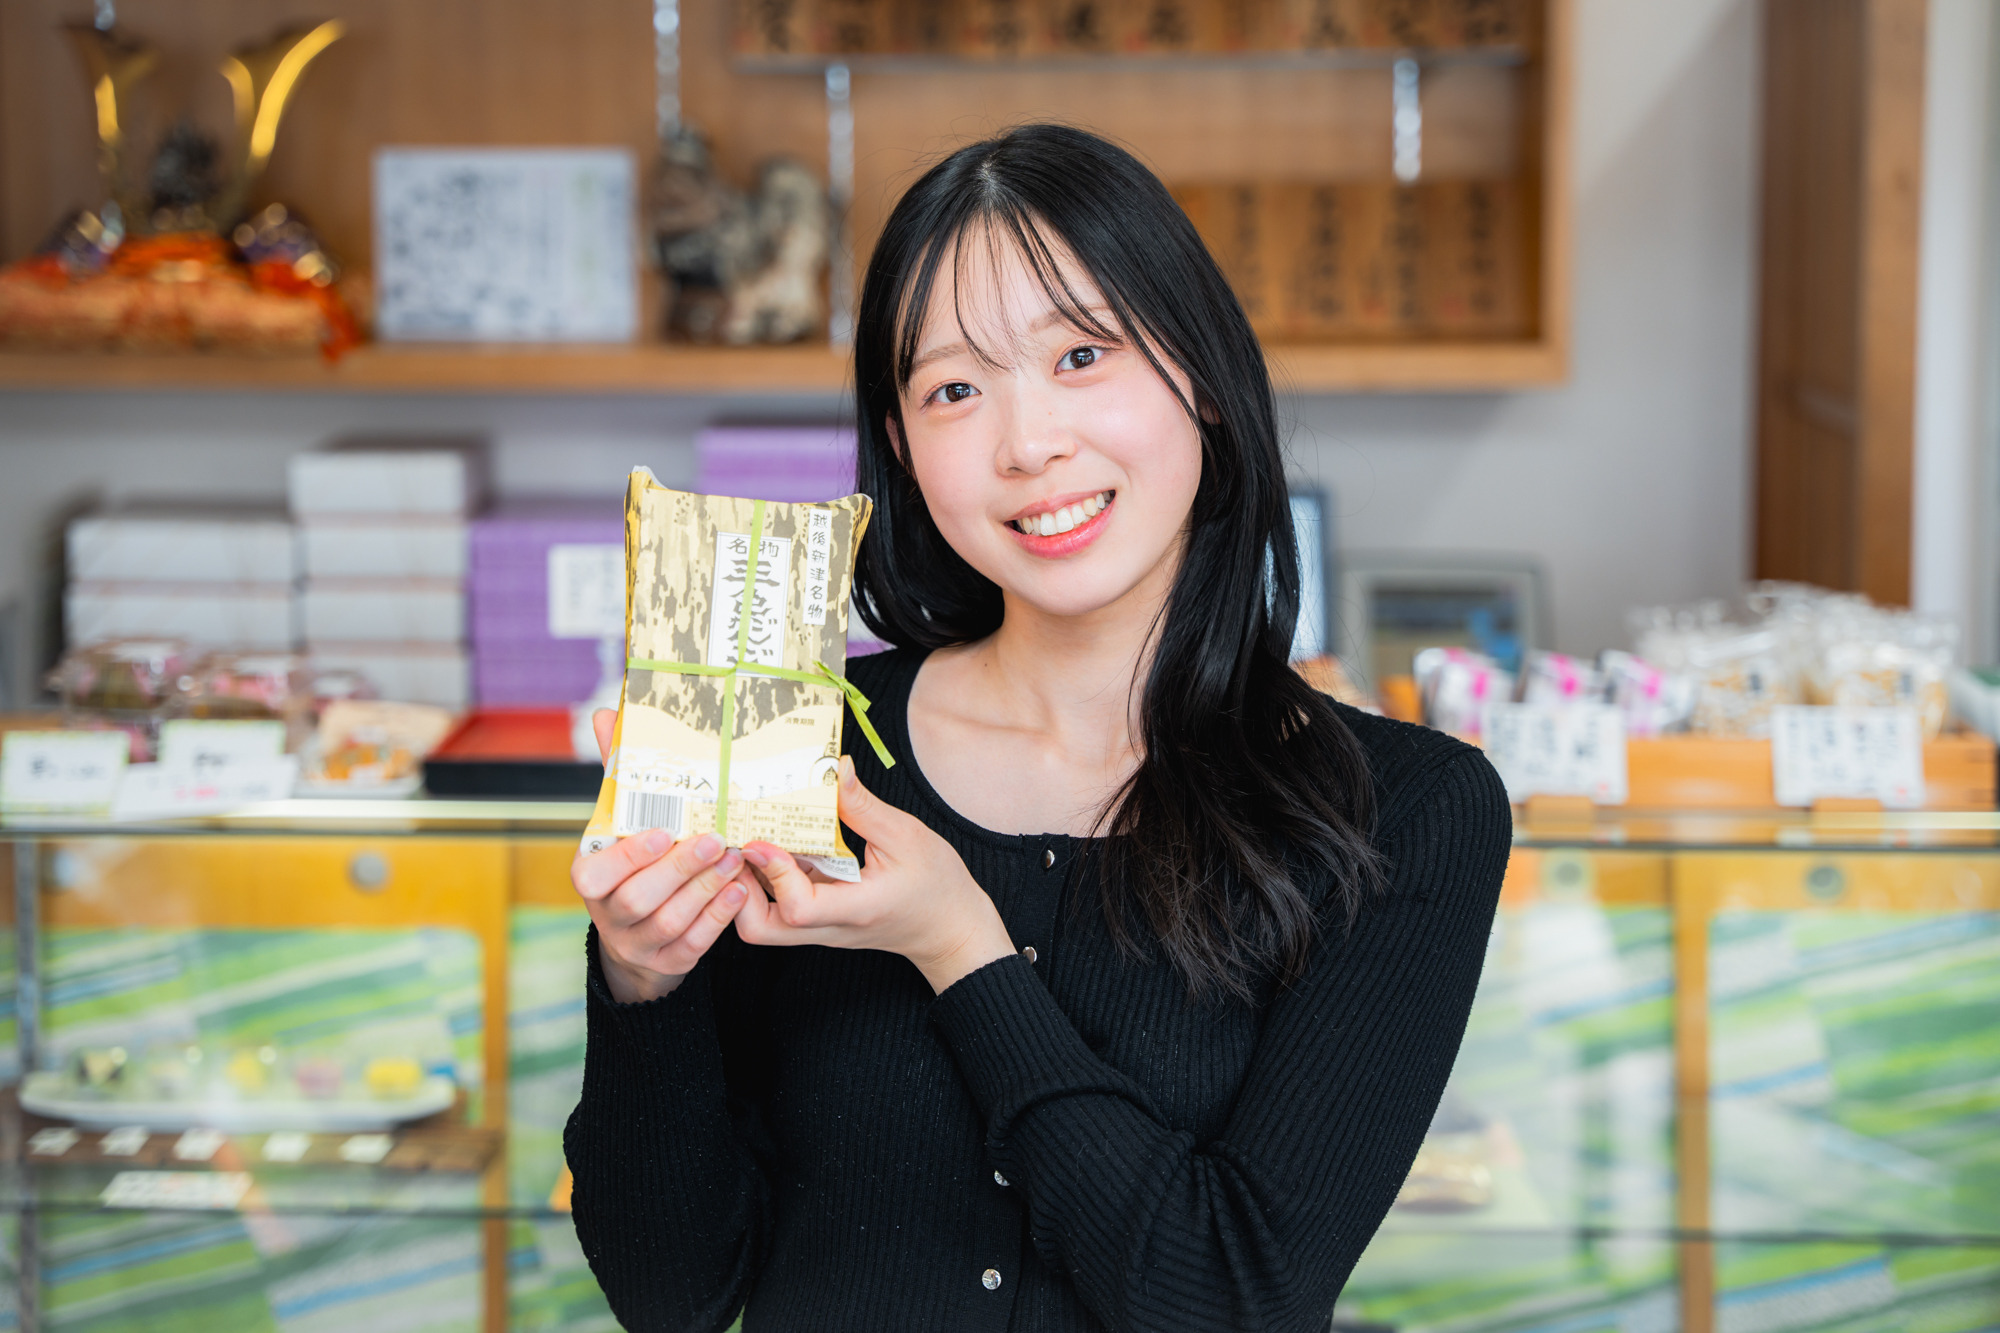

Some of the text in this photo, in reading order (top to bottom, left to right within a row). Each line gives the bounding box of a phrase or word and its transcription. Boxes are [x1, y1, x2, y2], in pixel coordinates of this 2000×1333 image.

[727, 537, 779, 558] 名物
[807, 512, 829, 619] 越後新津名物
